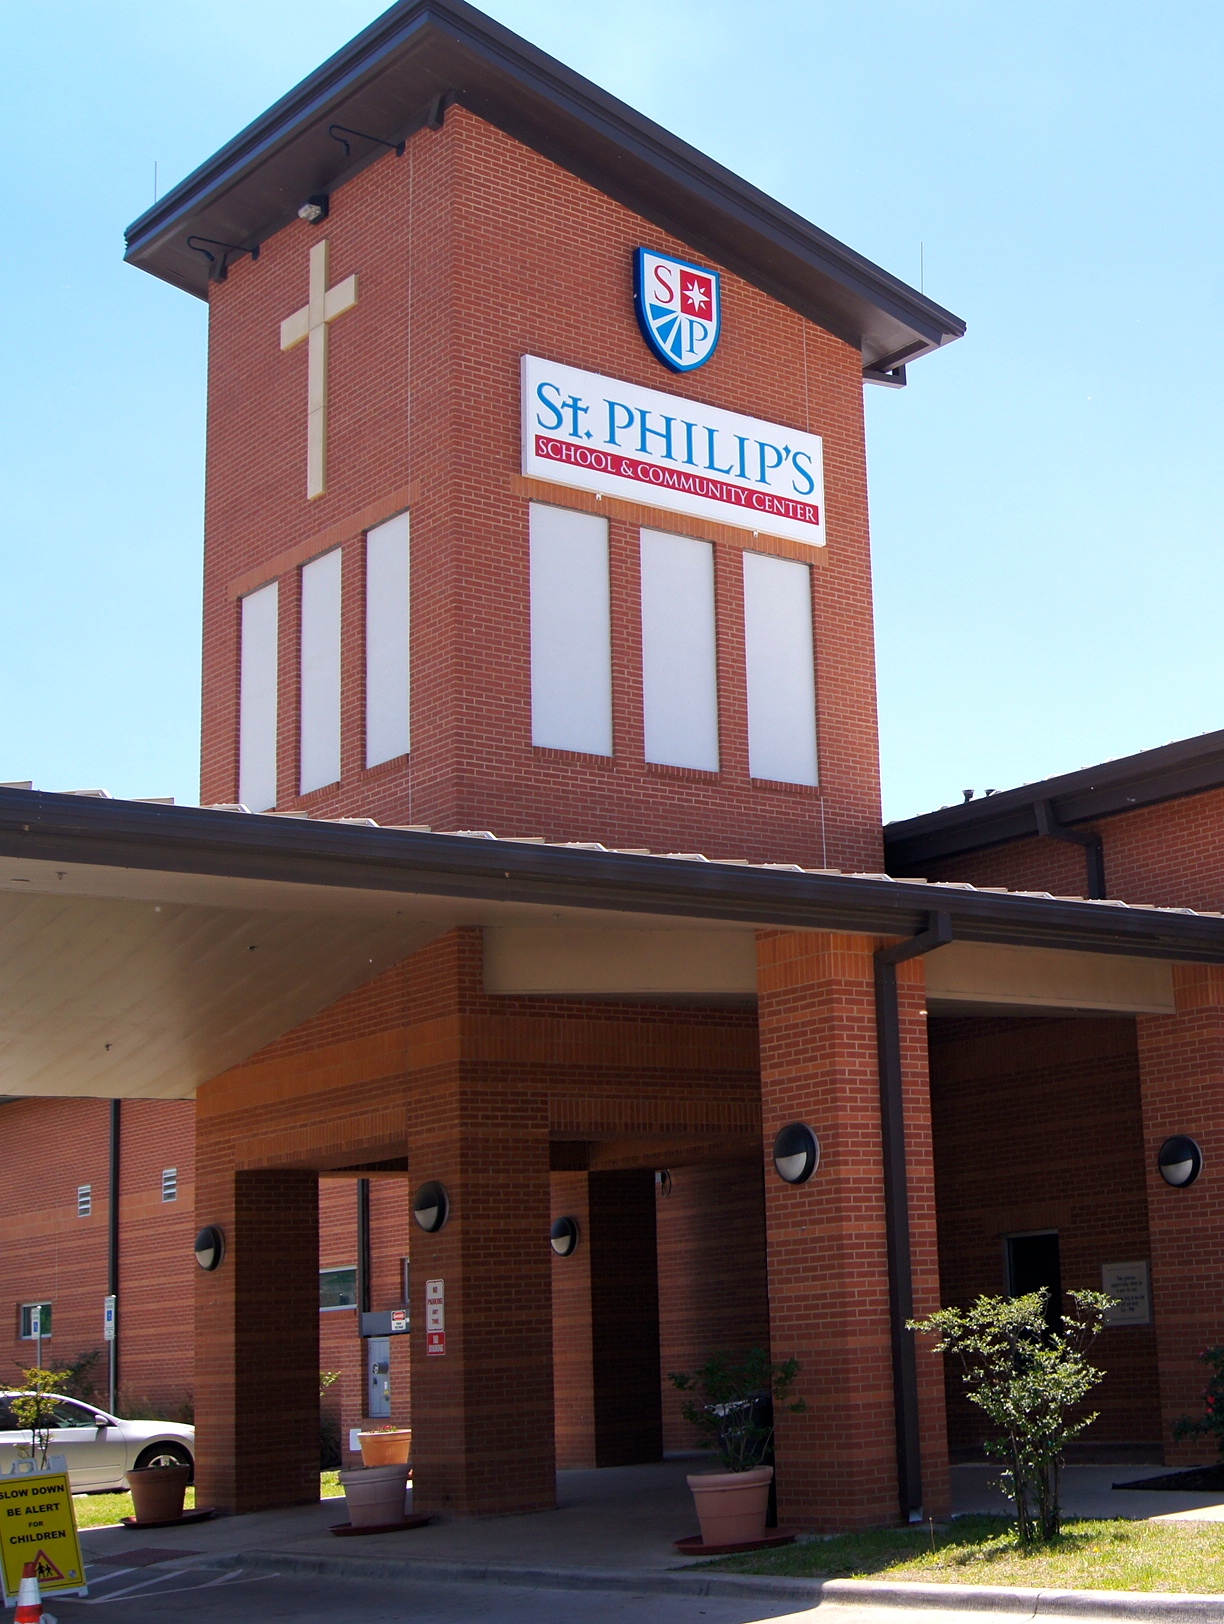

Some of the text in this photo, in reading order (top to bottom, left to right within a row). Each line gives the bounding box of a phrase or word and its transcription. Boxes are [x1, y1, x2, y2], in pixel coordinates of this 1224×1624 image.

[654, 264, 674, 304] S
[685, 317, 708, 355] P
[536, 382, 815, 496] St. PHILIP'S
[538, 439, 816, 523] SCHOOL & COMMUNITY CENTER
[0, 1484, 65, 1500] SLOW DOWN
[7, 1502, 60, 1517] BE ALERT
[10, 1529, 66, 1545] CHILDREN
[28, 1520, 44, 1528] FOR
